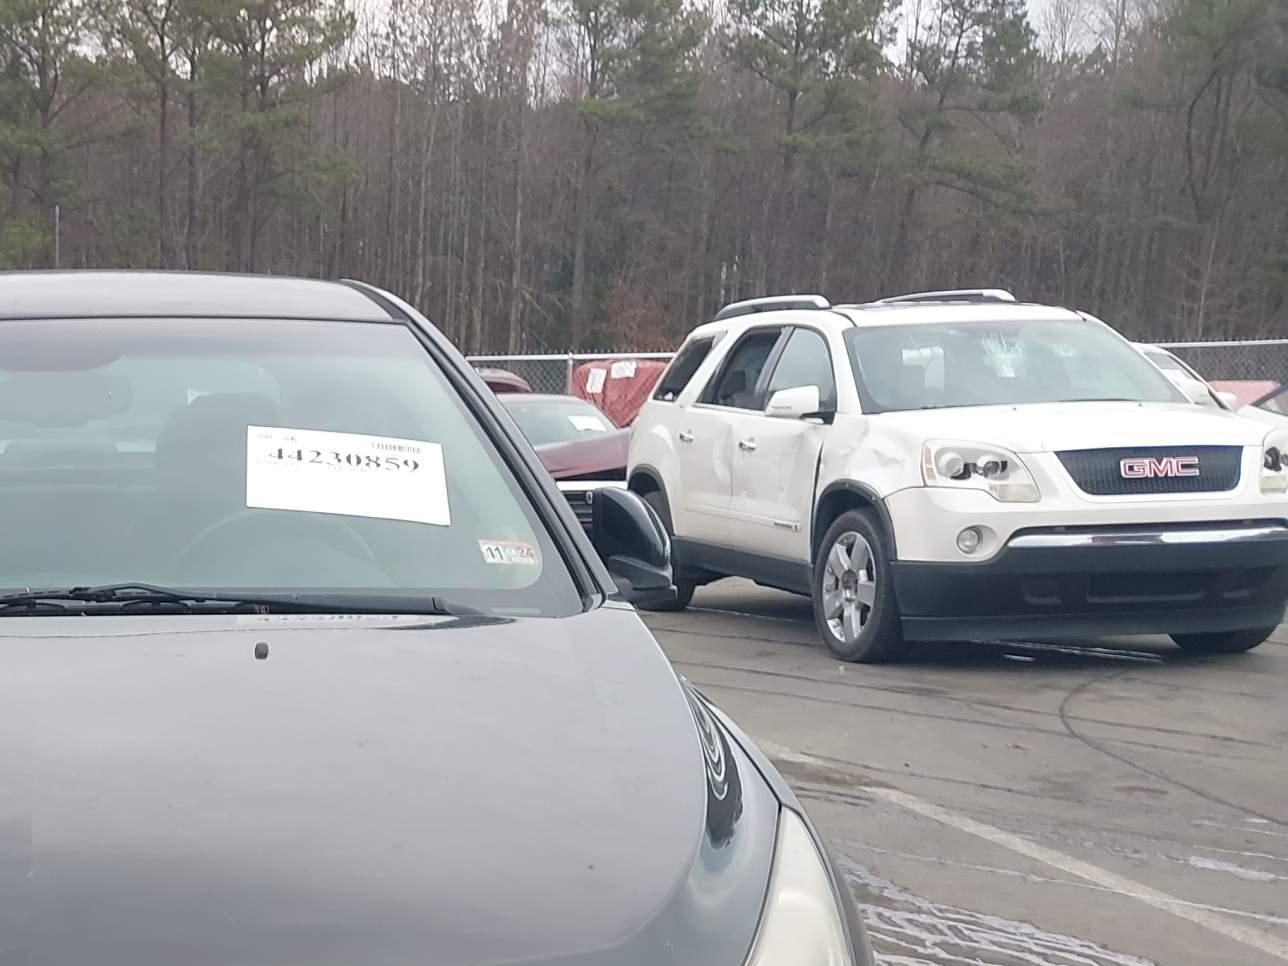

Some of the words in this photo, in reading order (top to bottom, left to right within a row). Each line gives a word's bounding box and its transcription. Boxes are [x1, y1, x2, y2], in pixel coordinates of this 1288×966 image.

[268, 448, 419, 473] 44230859
[1120, 456, 1200, 478] GMC
[486, 546, 504, 560] 11
